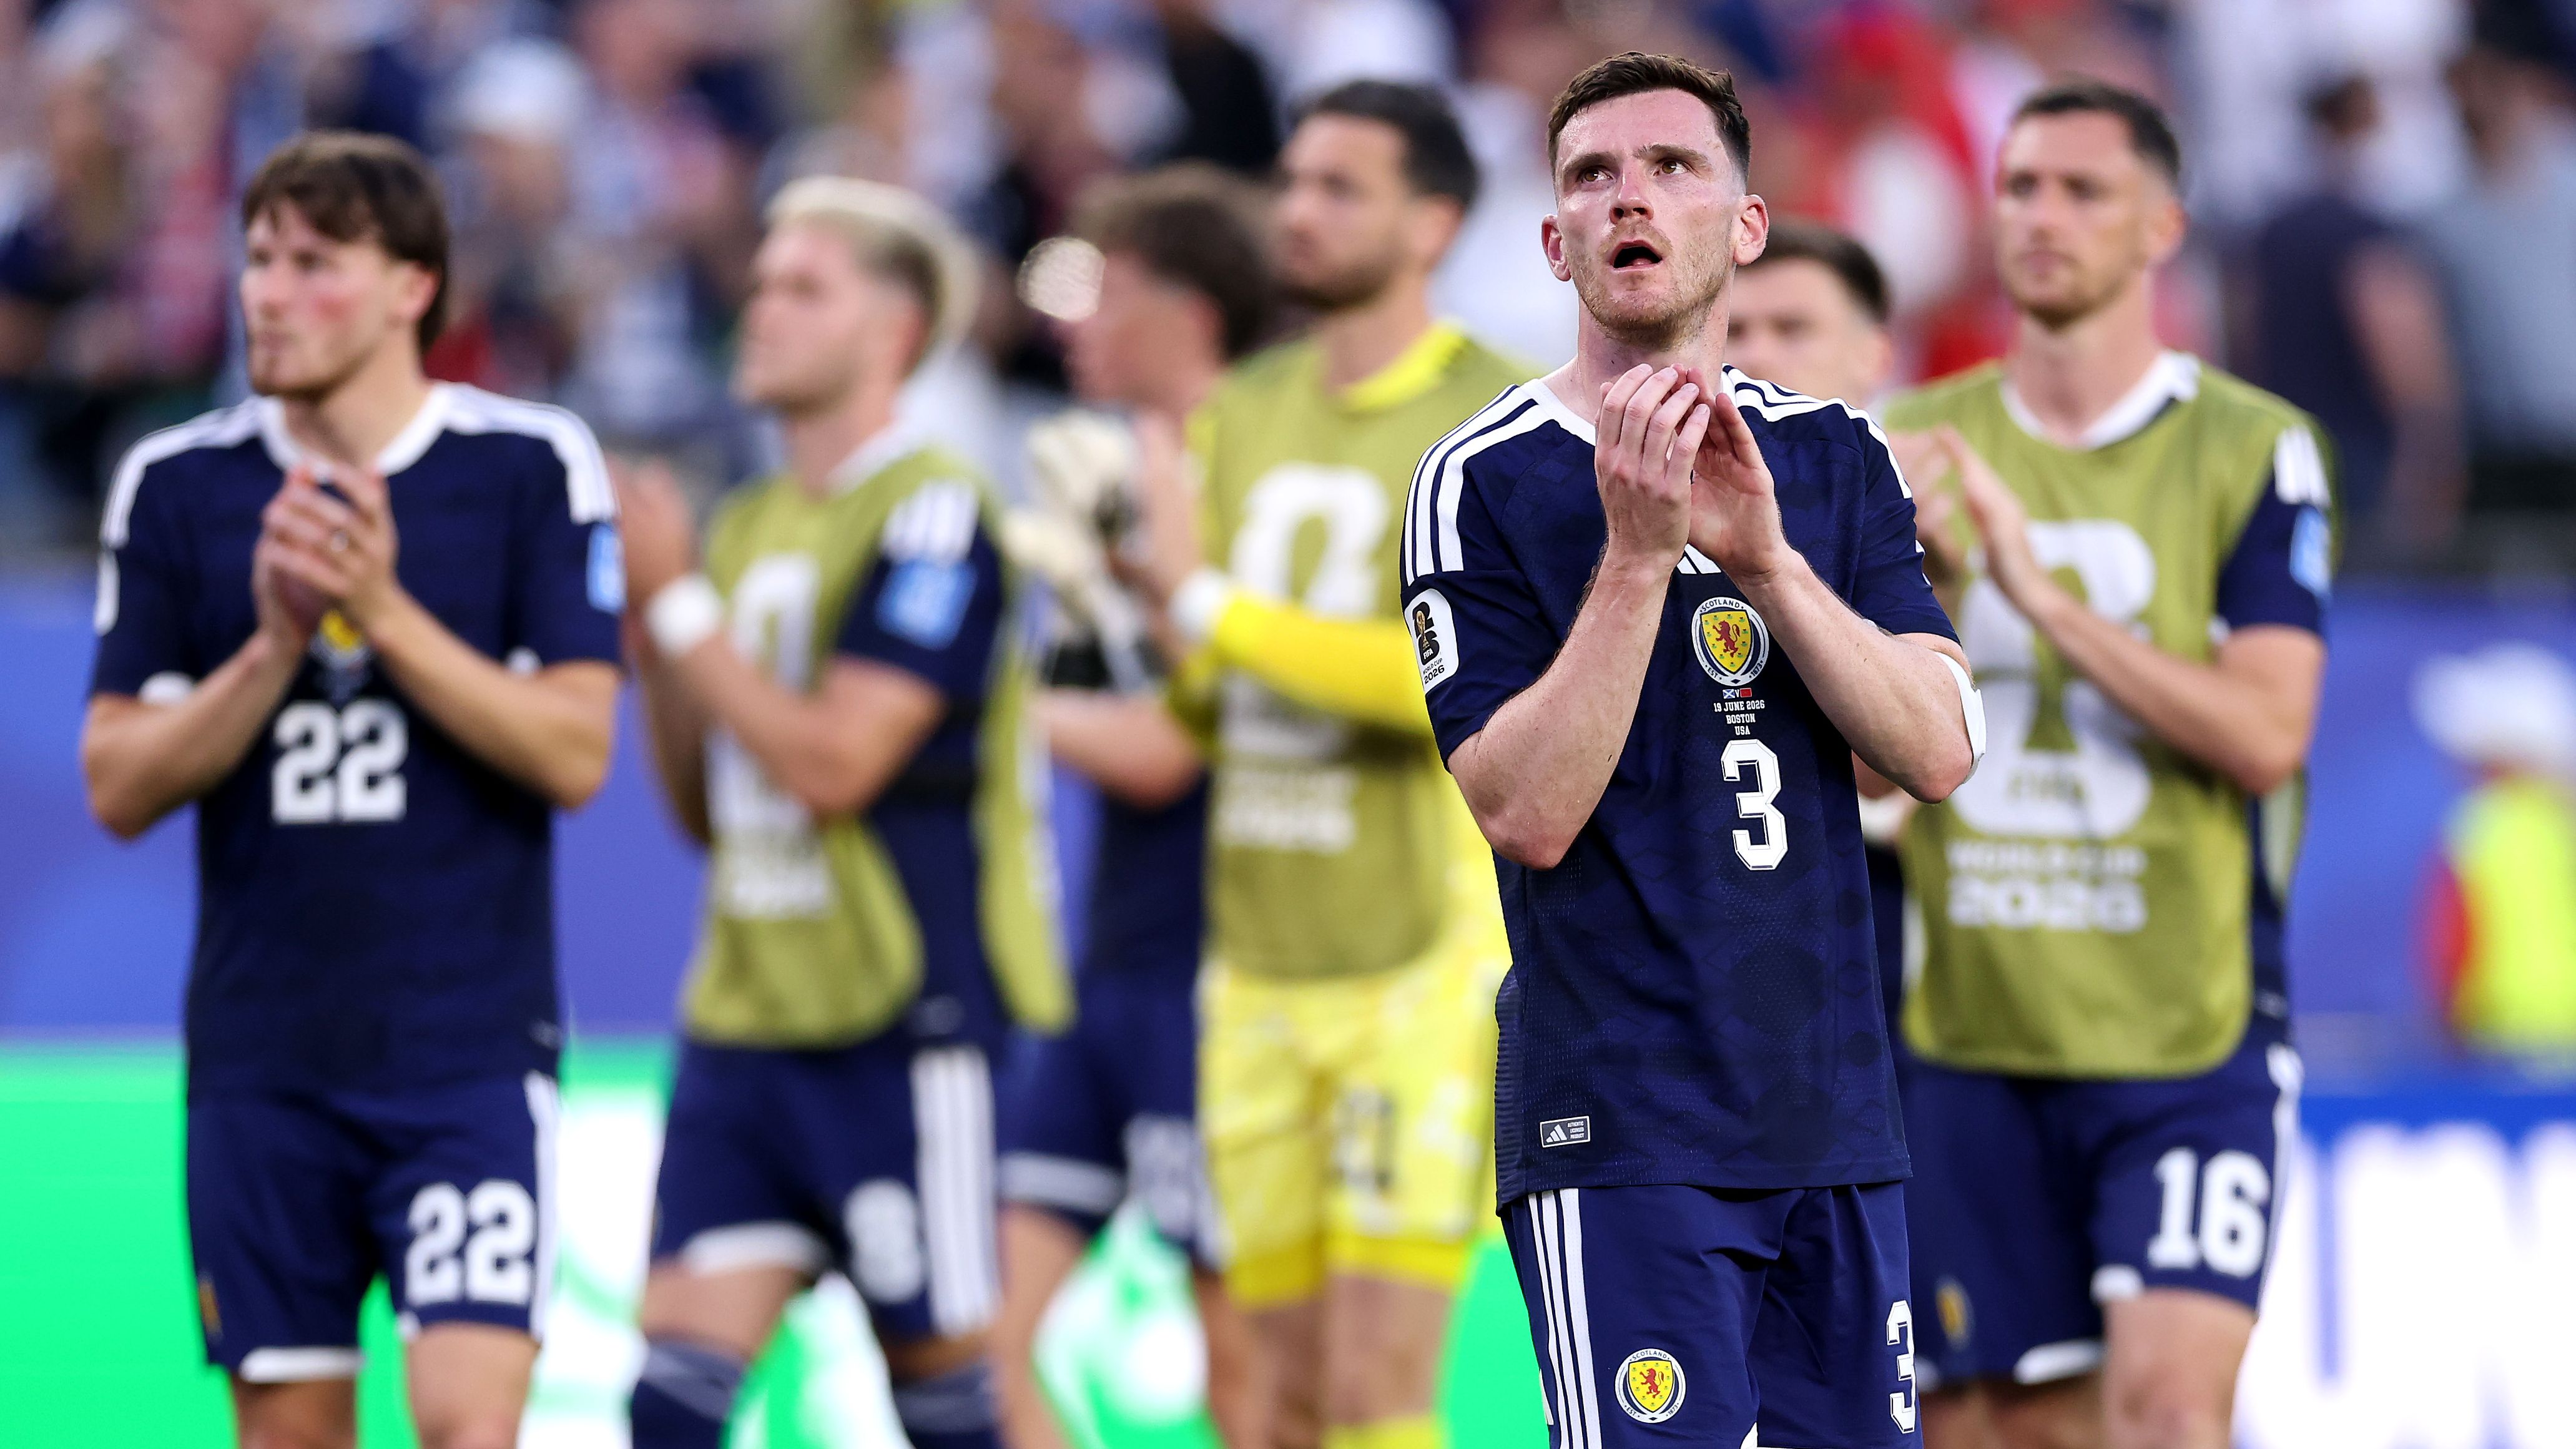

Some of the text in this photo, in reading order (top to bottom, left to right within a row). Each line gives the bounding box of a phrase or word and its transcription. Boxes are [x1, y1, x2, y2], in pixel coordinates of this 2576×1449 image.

[1701, 599, 1740, 611] SCOTLAND
[1423, 648, 1434, 660] FIFA
[1423, 658, 1443, 675] WORLD CUP
[1708, 667, 1718, 678] EST
[1751, 662, 1763, 677] 1873
[1424, 665, 1445, 684] 2026
[1734, 689, 1740, 697] V
[1713, 700, 1766, 712] 19 JUNE 2026
[1725, 714, 1756, 724] BOSTON
[1734, 725, 1751, 735] USA
[272, 700, 409, 825] 22
[1720, 739, 1788, 870] 3
[1947, 875, 2148, 931] 2026
[2146, 1147, 2271, 1277] 16
[404, 1178, 535, 1307] 22
[1632, 1350, 1667, 1360] SCOTLAND
[1886, 1300, 1915, 1434] 3
[1626, 1407, 1636, 1416] EST
[1668, 1405, 1679, 1415] 1873
